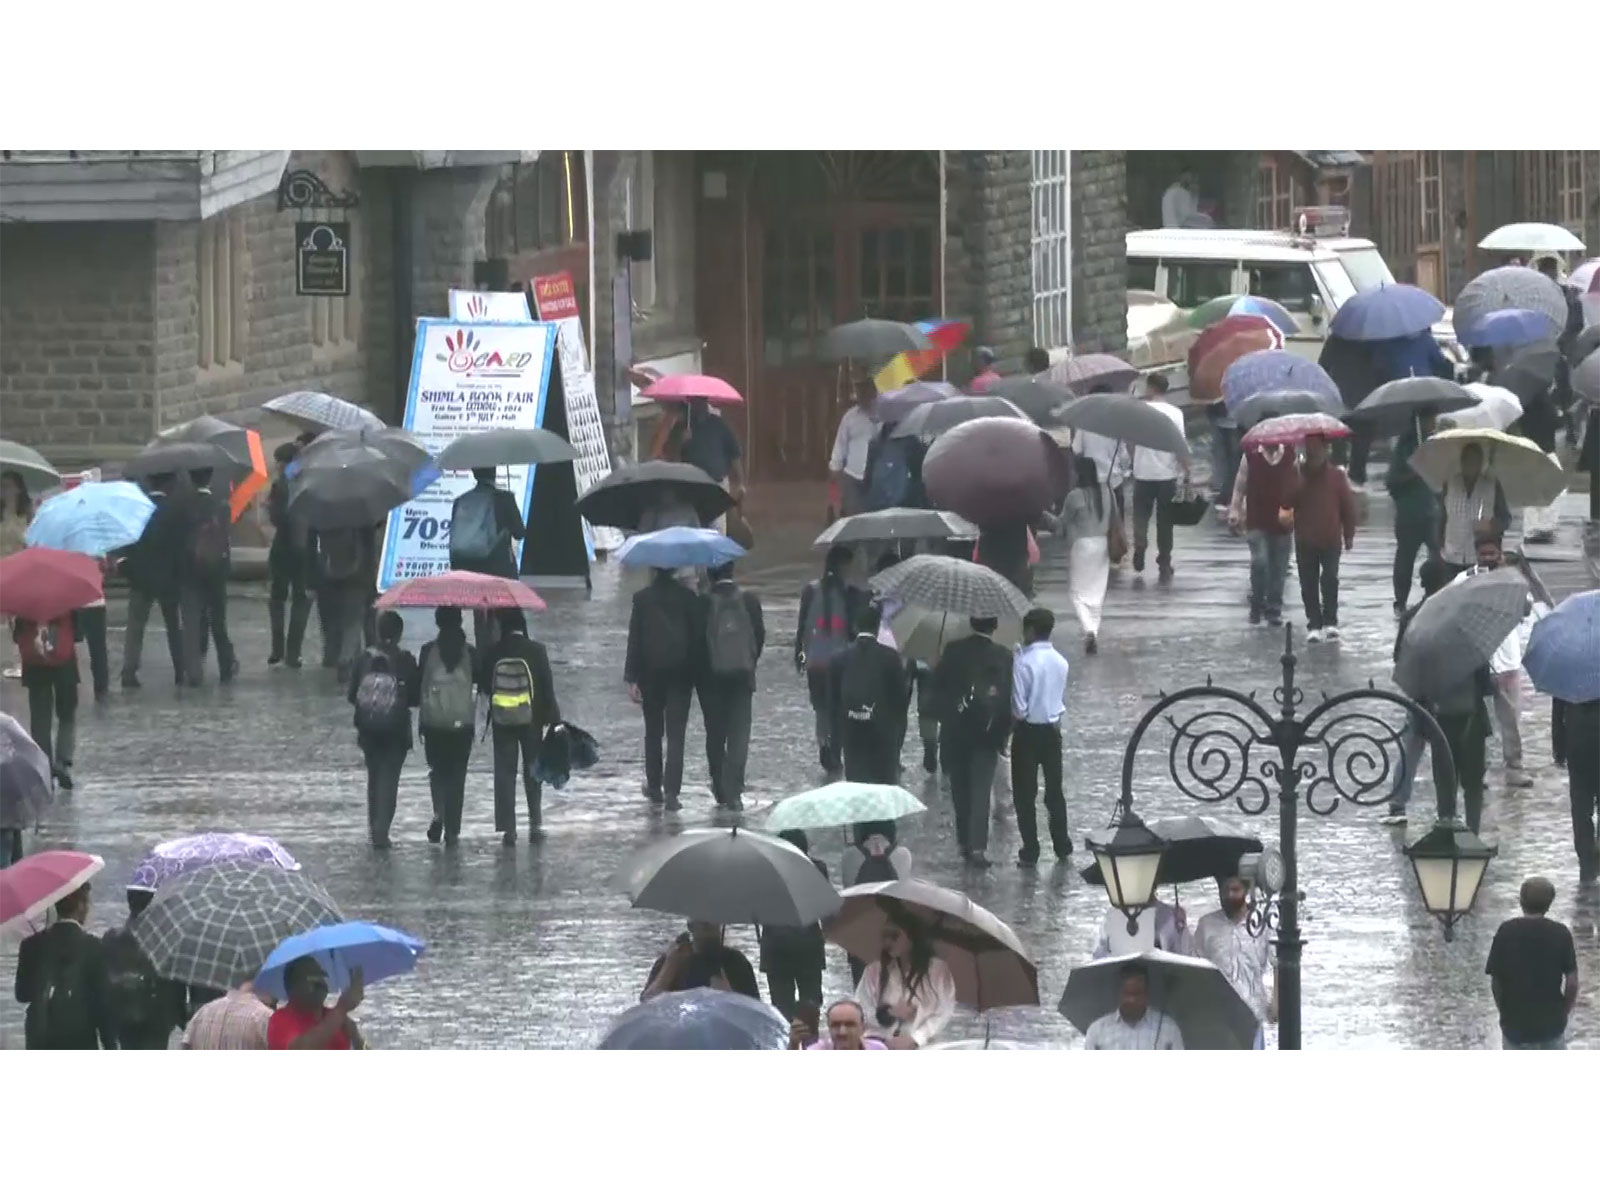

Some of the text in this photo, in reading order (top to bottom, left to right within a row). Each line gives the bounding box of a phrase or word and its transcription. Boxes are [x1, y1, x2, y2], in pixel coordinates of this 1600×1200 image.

[420, 390, 534, 403] SHIMLA BOOK FAIR
